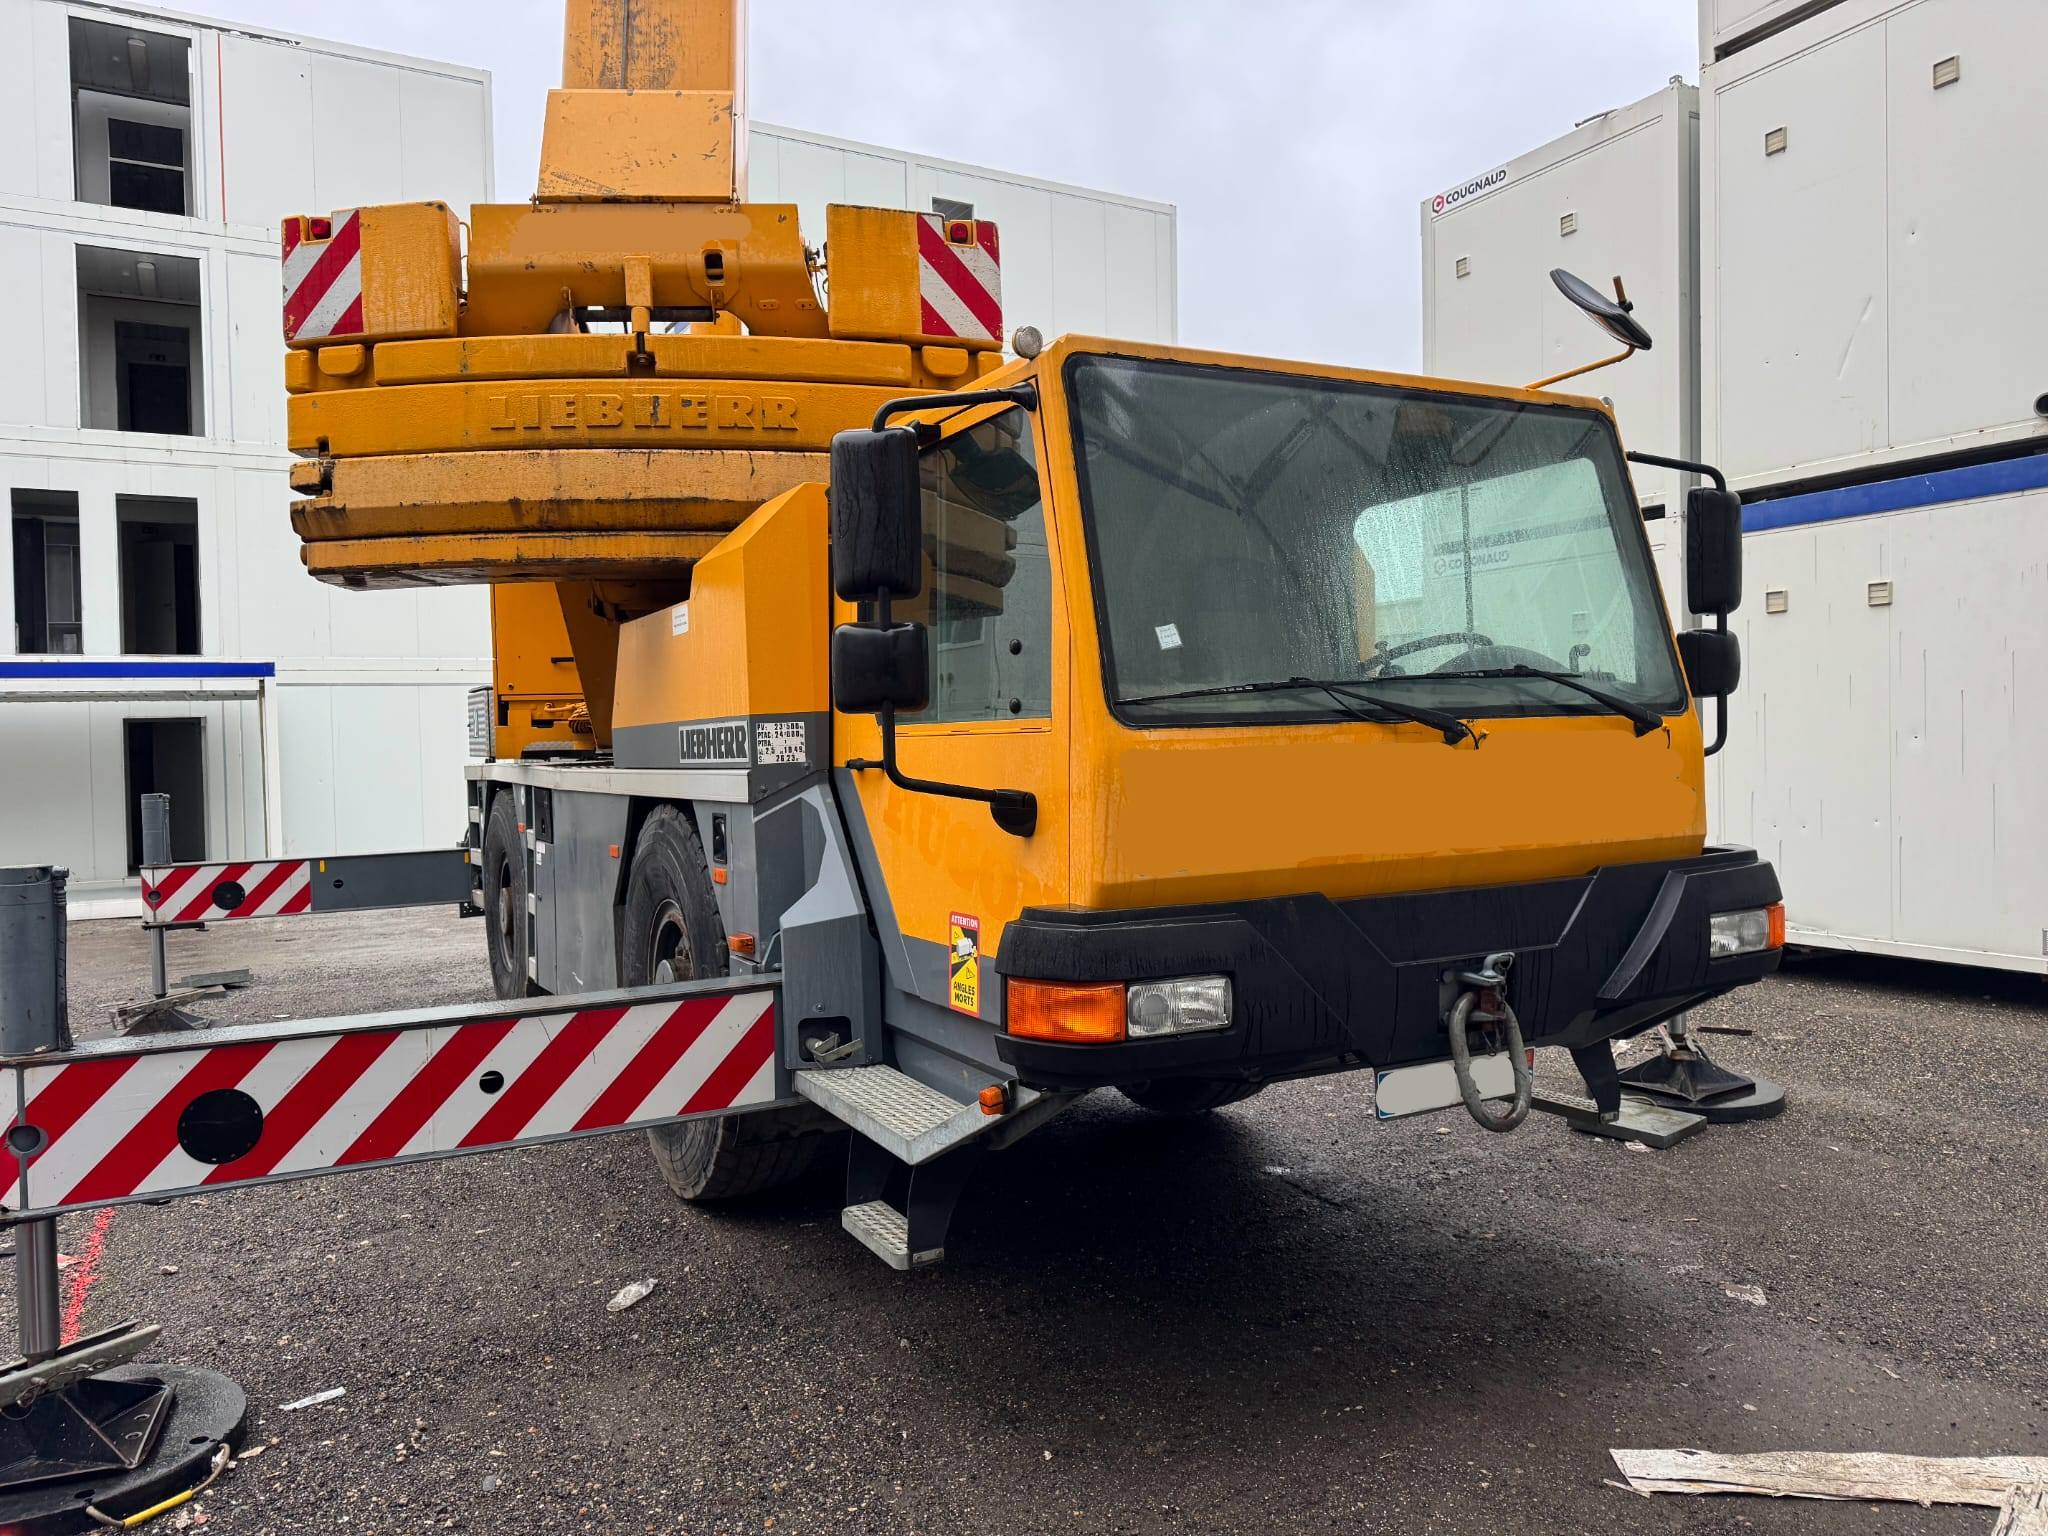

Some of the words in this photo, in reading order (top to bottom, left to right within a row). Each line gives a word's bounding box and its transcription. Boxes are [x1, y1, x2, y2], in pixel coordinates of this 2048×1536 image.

[1445, 169, 1507, 205] COUGNAUD
[489, 393, 799, 431] LIEBHERR
[1448, 550, 1510, 570] COGNAUD
[680, 725, 747, 760] LIEBHERR
[951, 914, 978, 929] ATTENTION
[953, 981, 975, 996] ANGLES
[954, 991, 974, 1007] MORTS
